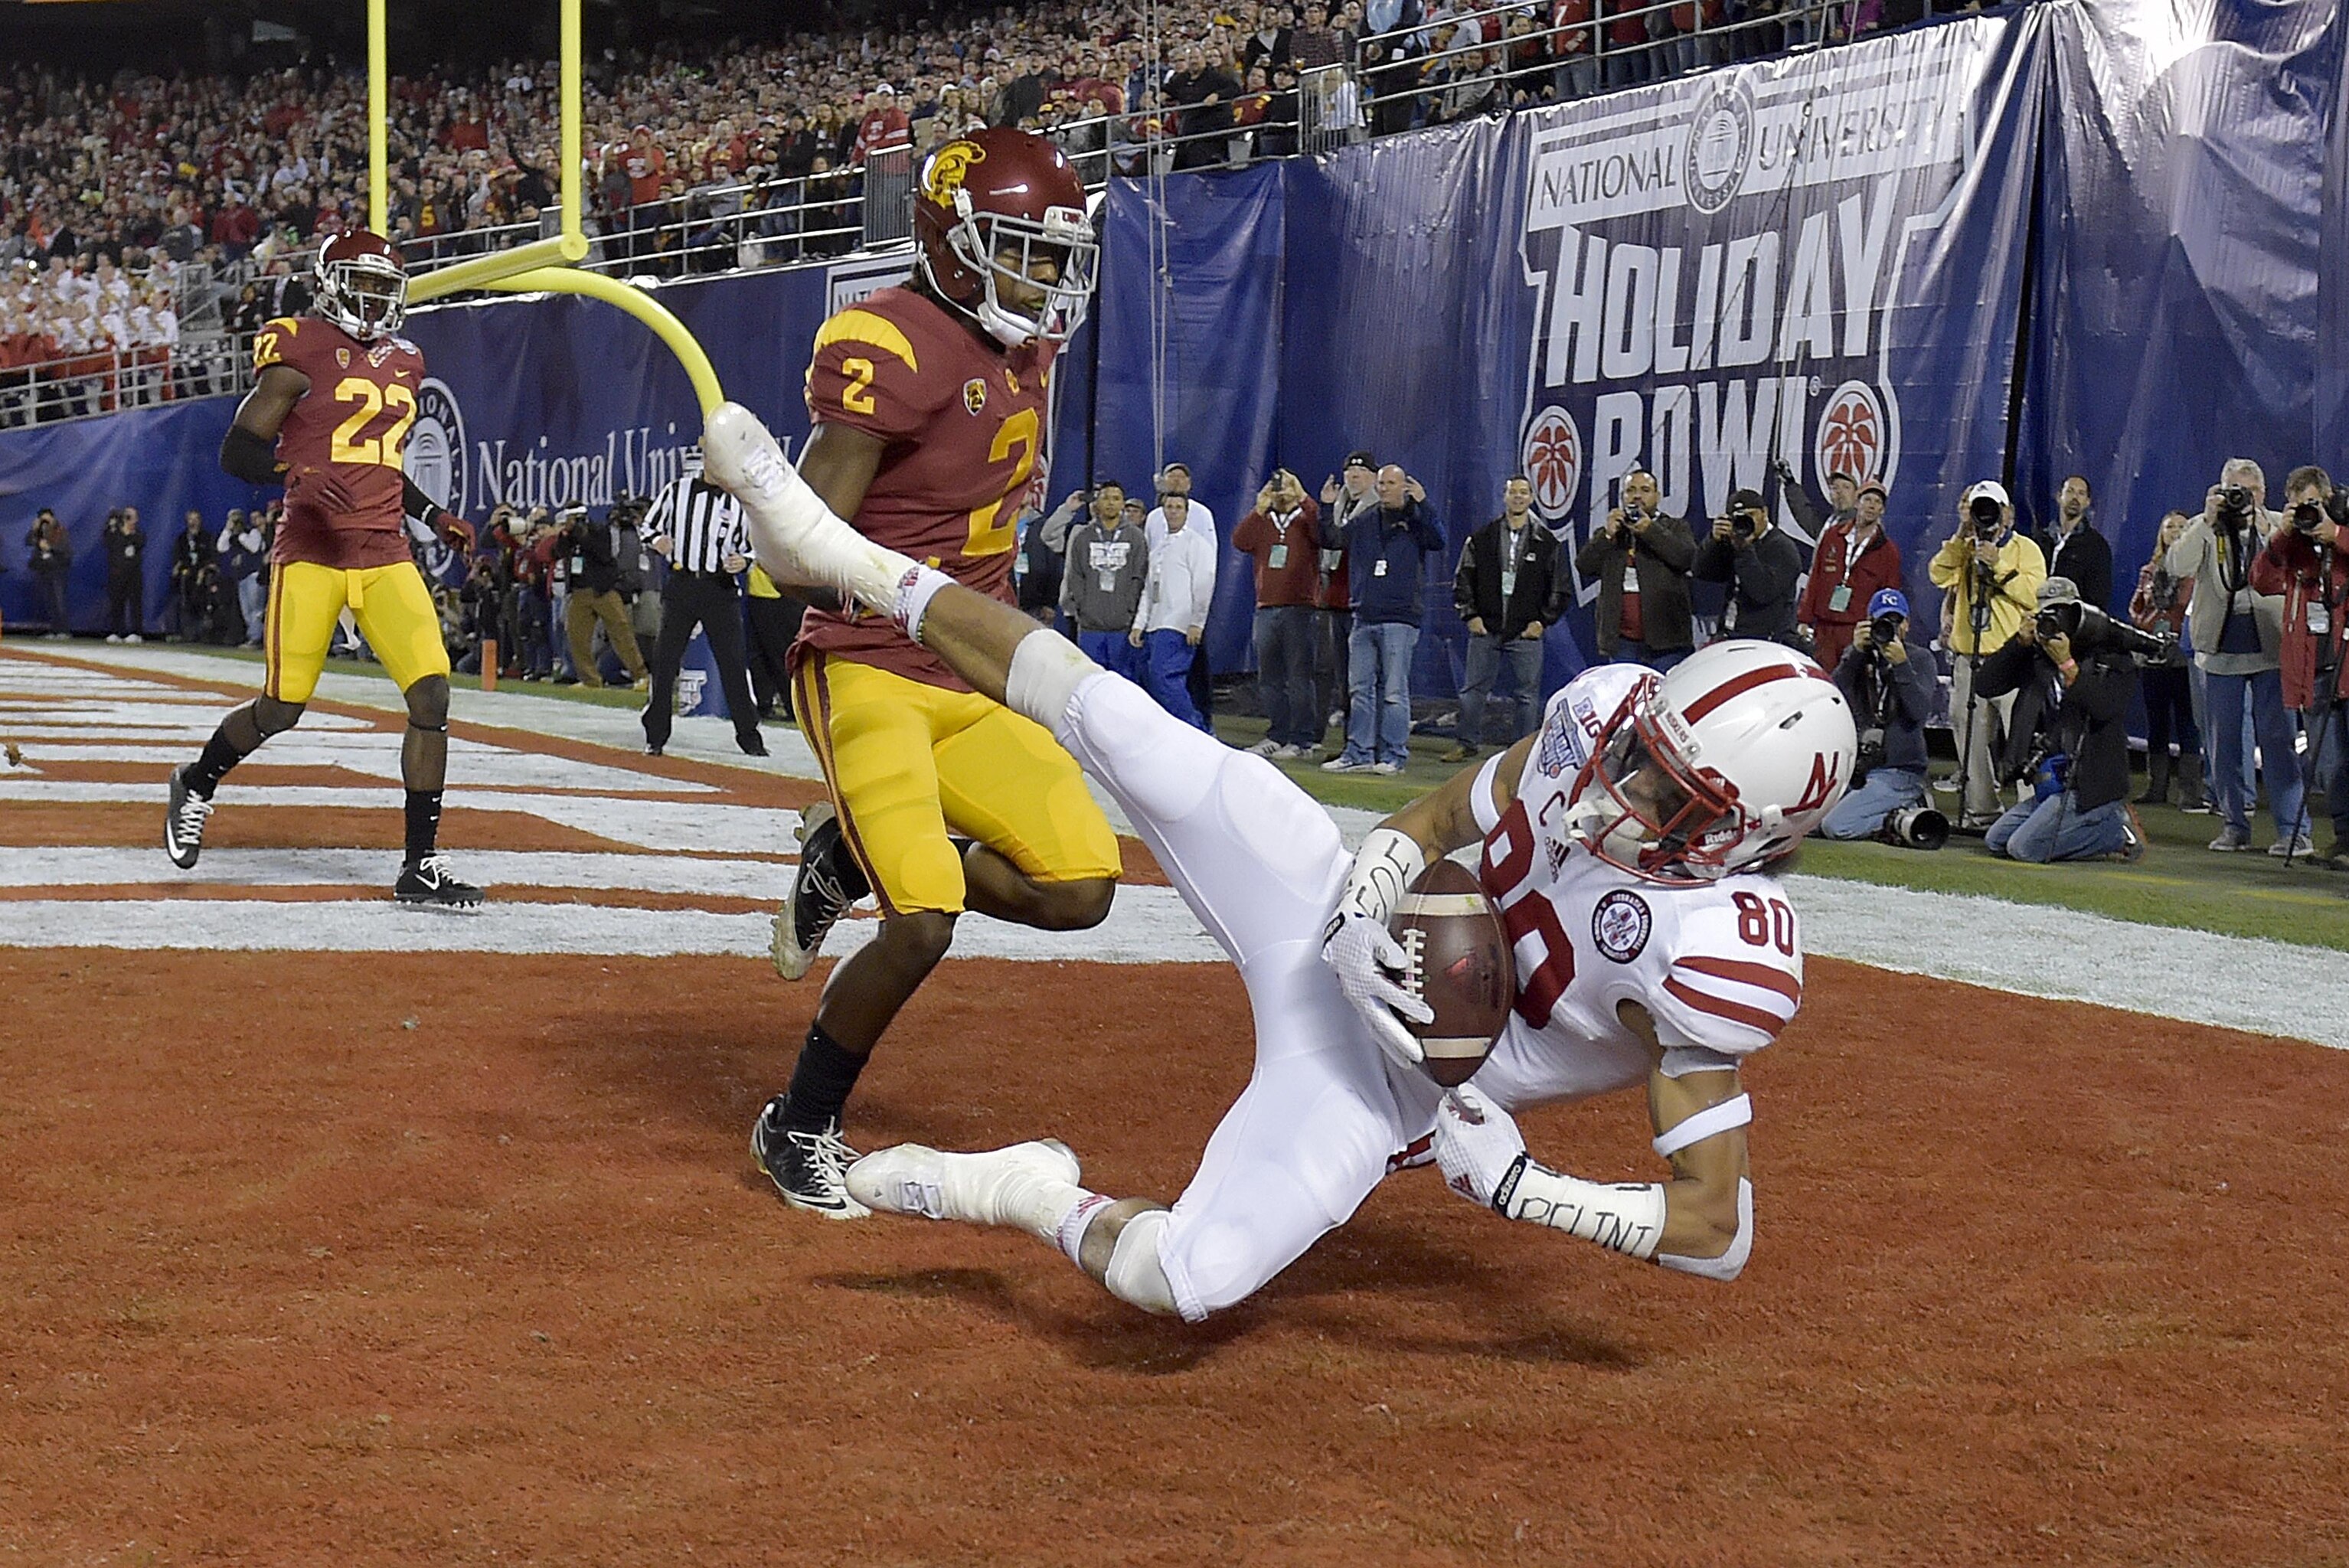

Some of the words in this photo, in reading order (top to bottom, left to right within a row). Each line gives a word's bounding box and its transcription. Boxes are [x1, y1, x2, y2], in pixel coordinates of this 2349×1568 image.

[1539, 142, 1677, 211] NATIONAL
[1545, 168, 1900, 387] HOLIDAY
[842, 358, 874, 415] 2
[332, 377, 418, 472] 22
[476, 436, 615, 511] National
[961, 407, 1039, 557] 2
[1881, 593, 1898, 606] KC
[1731, 891, 1794, 958] 80
